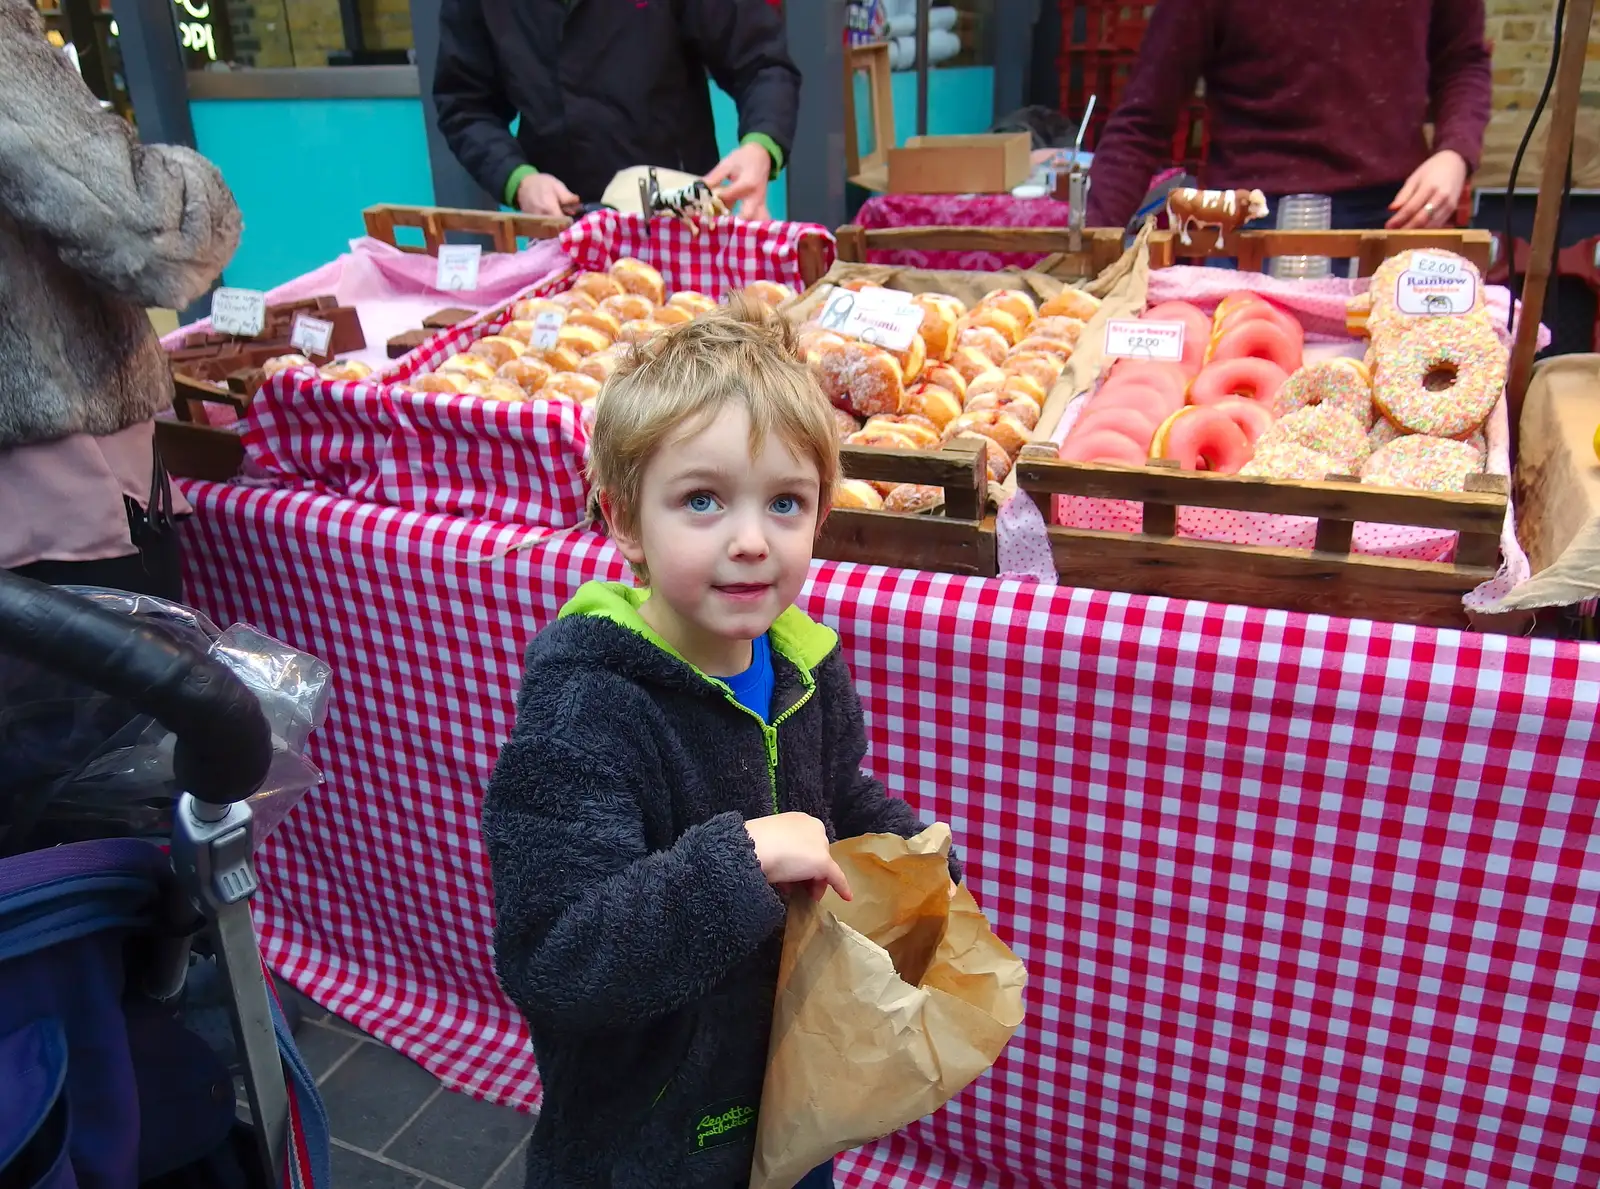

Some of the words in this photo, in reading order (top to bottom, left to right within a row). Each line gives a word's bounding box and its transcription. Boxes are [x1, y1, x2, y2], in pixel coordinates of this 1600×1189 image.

[1418, 258, 1456, 275] £2.00
[1406, 276, 1467, 286] Rainbow
[696, 1106, 756, 1134] Regatta
